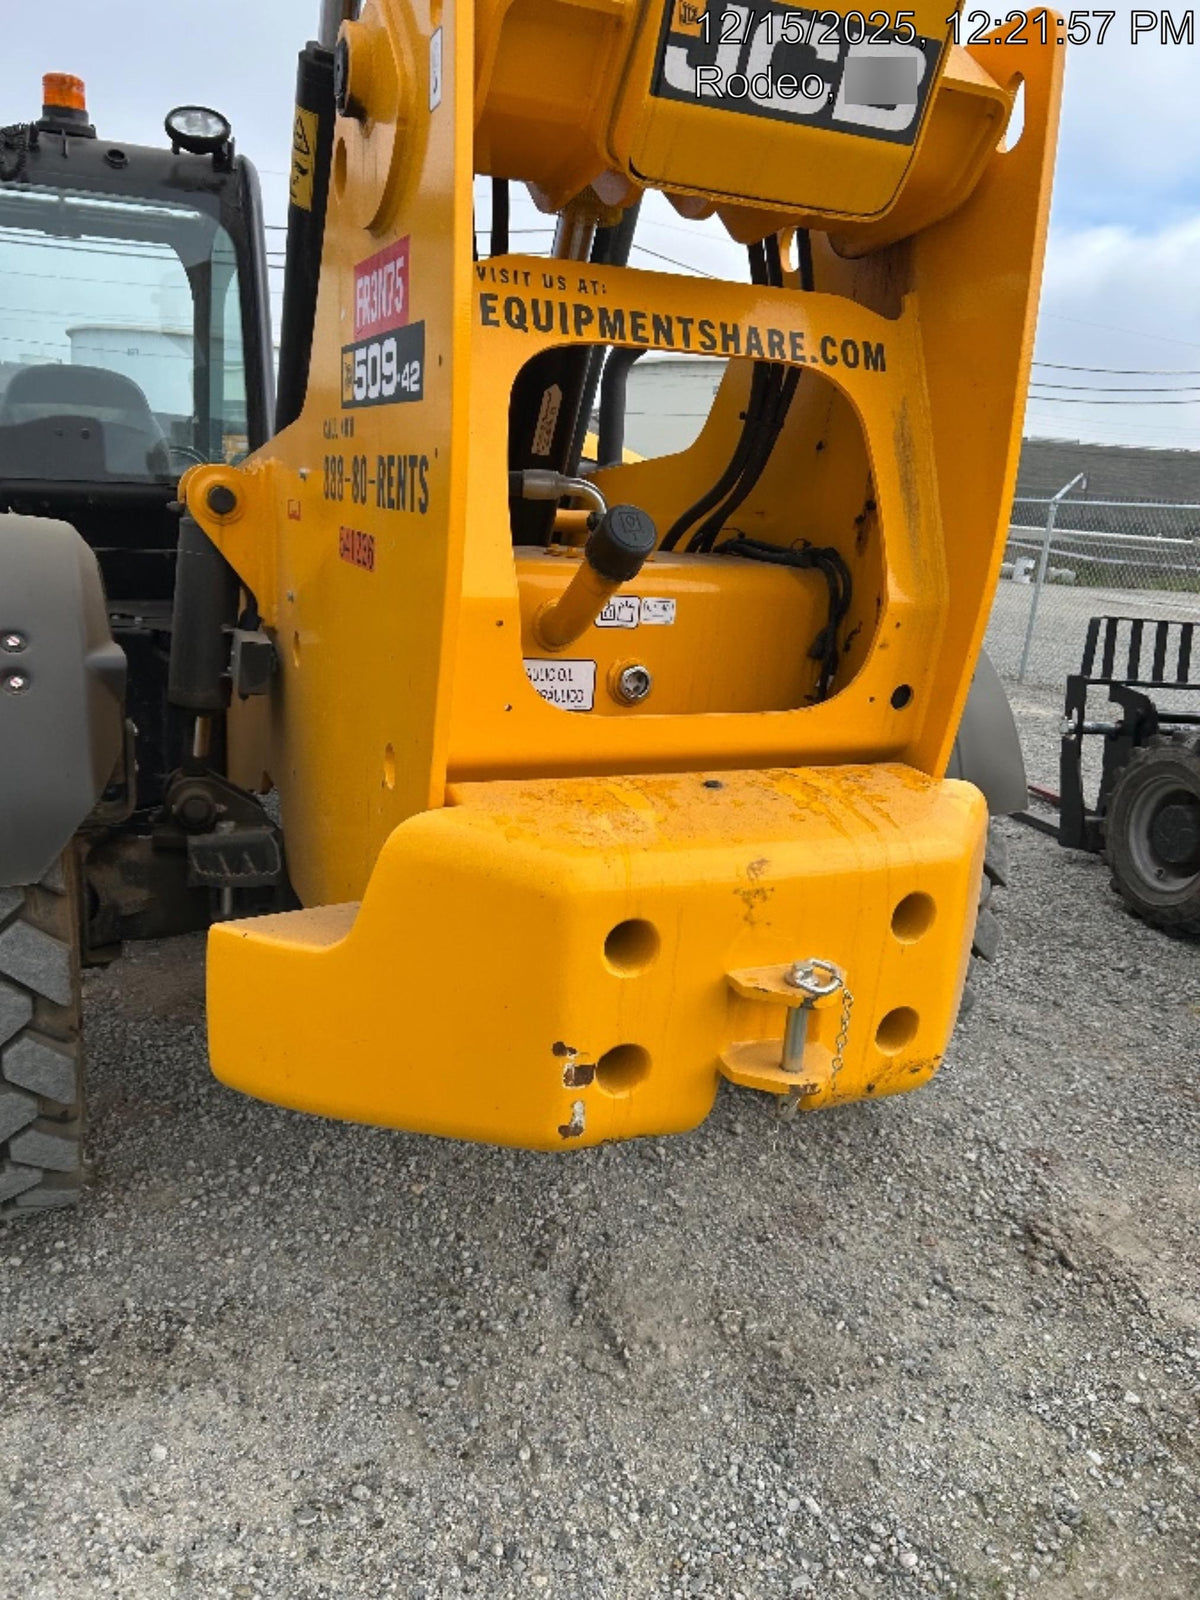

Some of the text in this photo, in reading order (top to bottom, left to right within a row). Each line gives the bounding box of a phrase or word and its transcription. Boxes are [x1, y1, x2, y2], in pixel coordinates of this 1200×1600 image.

[476, 264, 607, 296] VISIT US AT:
[480, 292, 887, 373] EQUIPMENTSHARE.COM
[323, 454, 429, 515] 888-80-RENTS
[526, 667, 555, 682] AULIC
